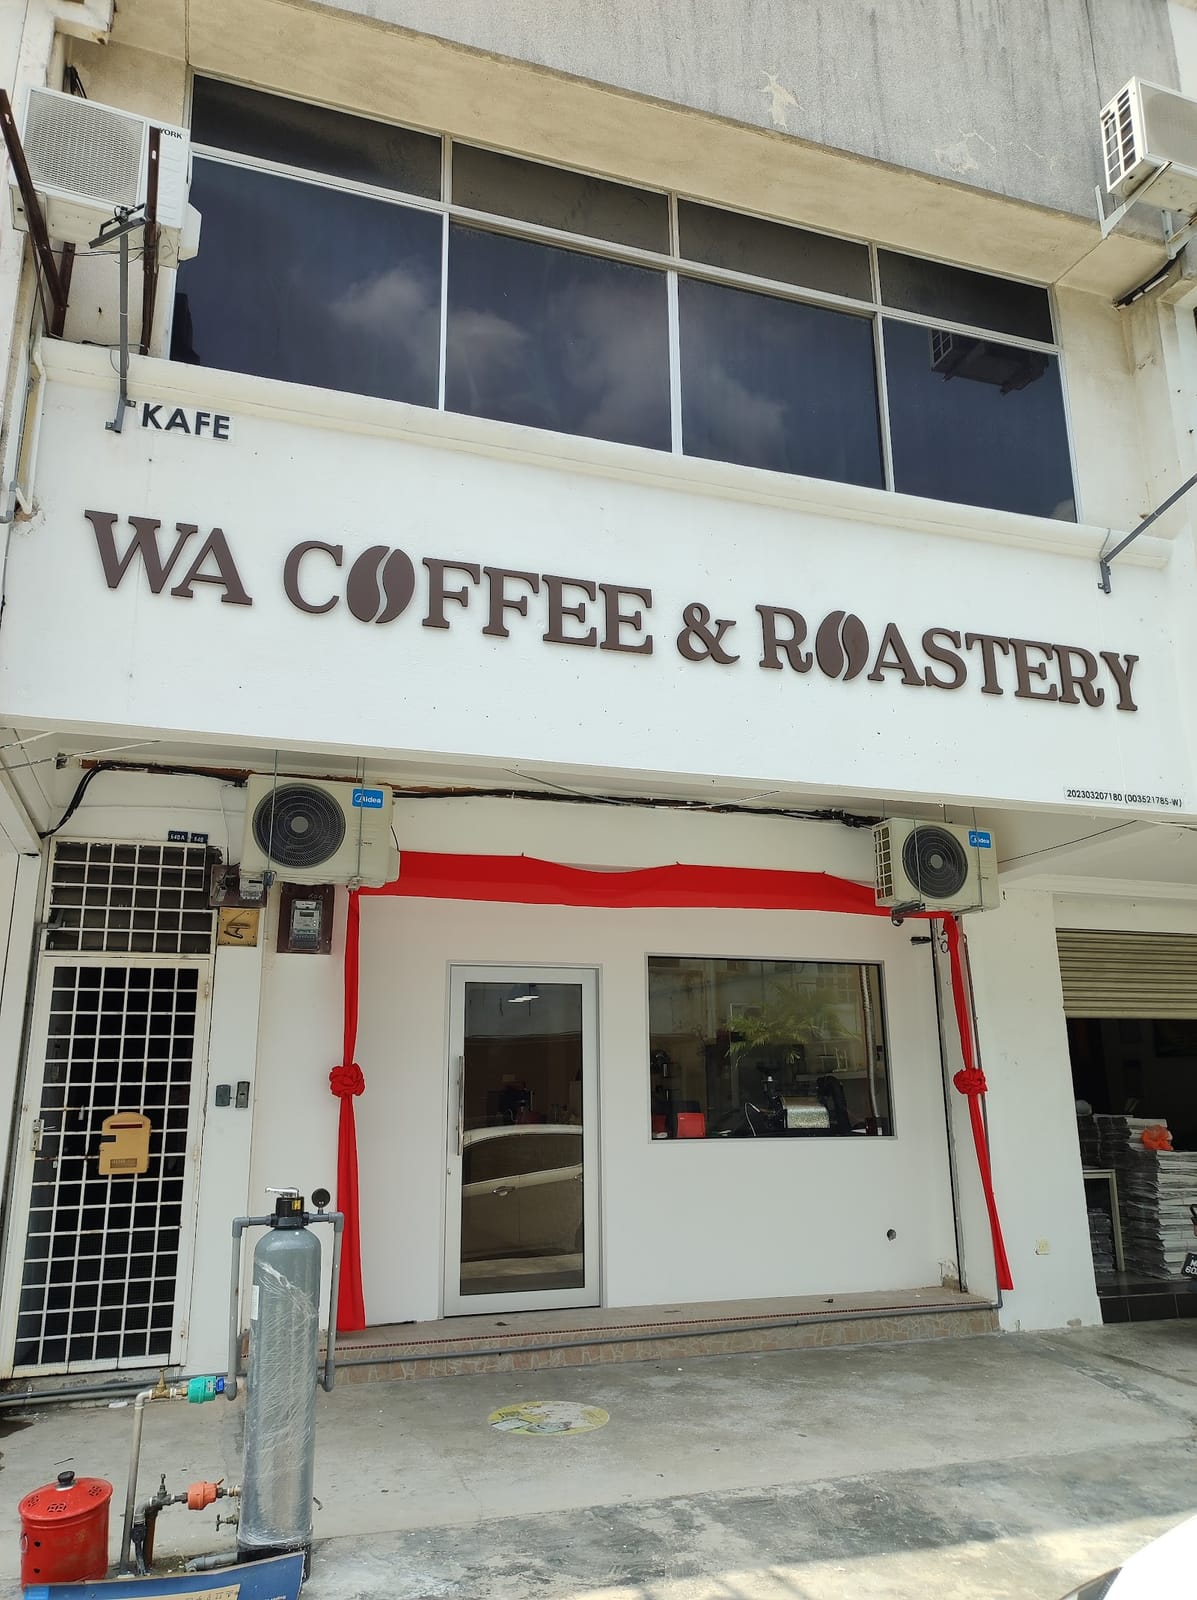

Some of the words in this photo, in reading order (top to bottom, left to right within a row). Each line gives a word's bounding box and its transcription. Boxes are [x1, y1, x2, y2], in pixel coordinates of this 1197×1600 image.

[160, 127, 182, 139] YORK
[142, 402, 230, 440] KAFE
[84, 510, 252, 606] WA
[284, 541, 653, 655] COFFEE
[677, 603, 741, 665] &
[755, 605, 1139, 712] ROASTERY
[1067, 789, 1122, 802] 202303207180
